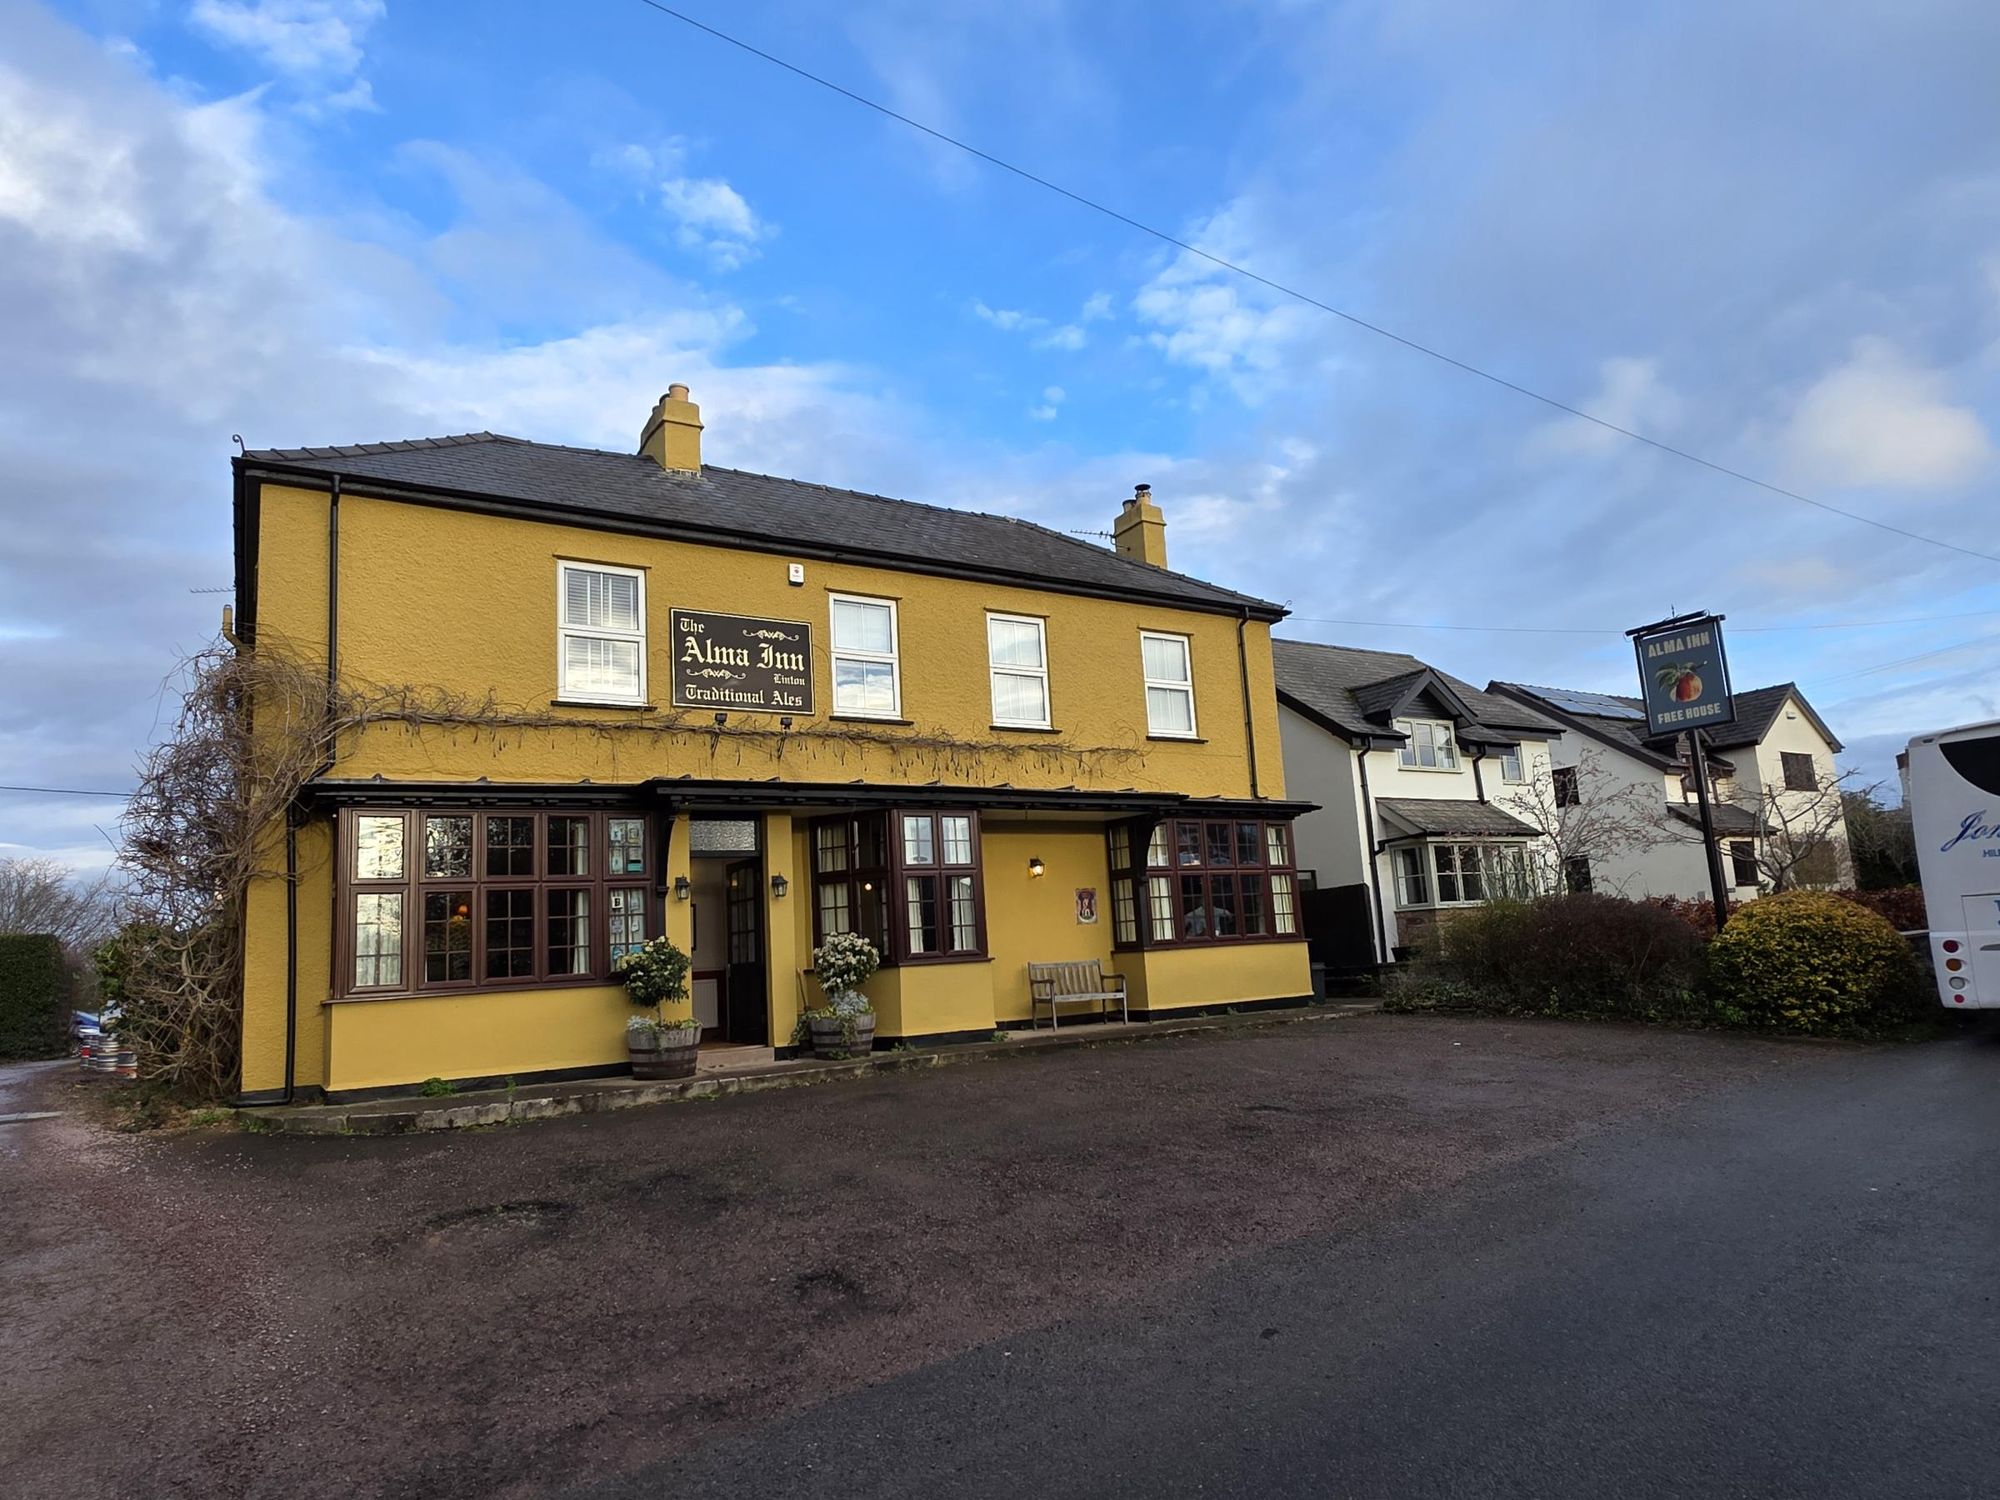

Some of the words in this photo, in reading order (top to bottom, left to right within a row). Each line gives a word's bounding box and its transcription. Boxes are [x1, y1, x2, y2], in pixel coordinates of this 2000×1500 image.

[680, 617, 705, 635] The
[681, 636, 750, 667] Alma
[756, 643, 805, 671] Inn
[1648, 638, 1684, 658] ALMA
[1686, 631, 1710, 649] INN
[773, 673, 806, 686] Linton
[685, 684, 765, 704] Traditional
[771, 690, 803, 706] Ales
[1657, 711, 1684, 724] FREE
[1685, 703, 1720, 719] HOUSE
